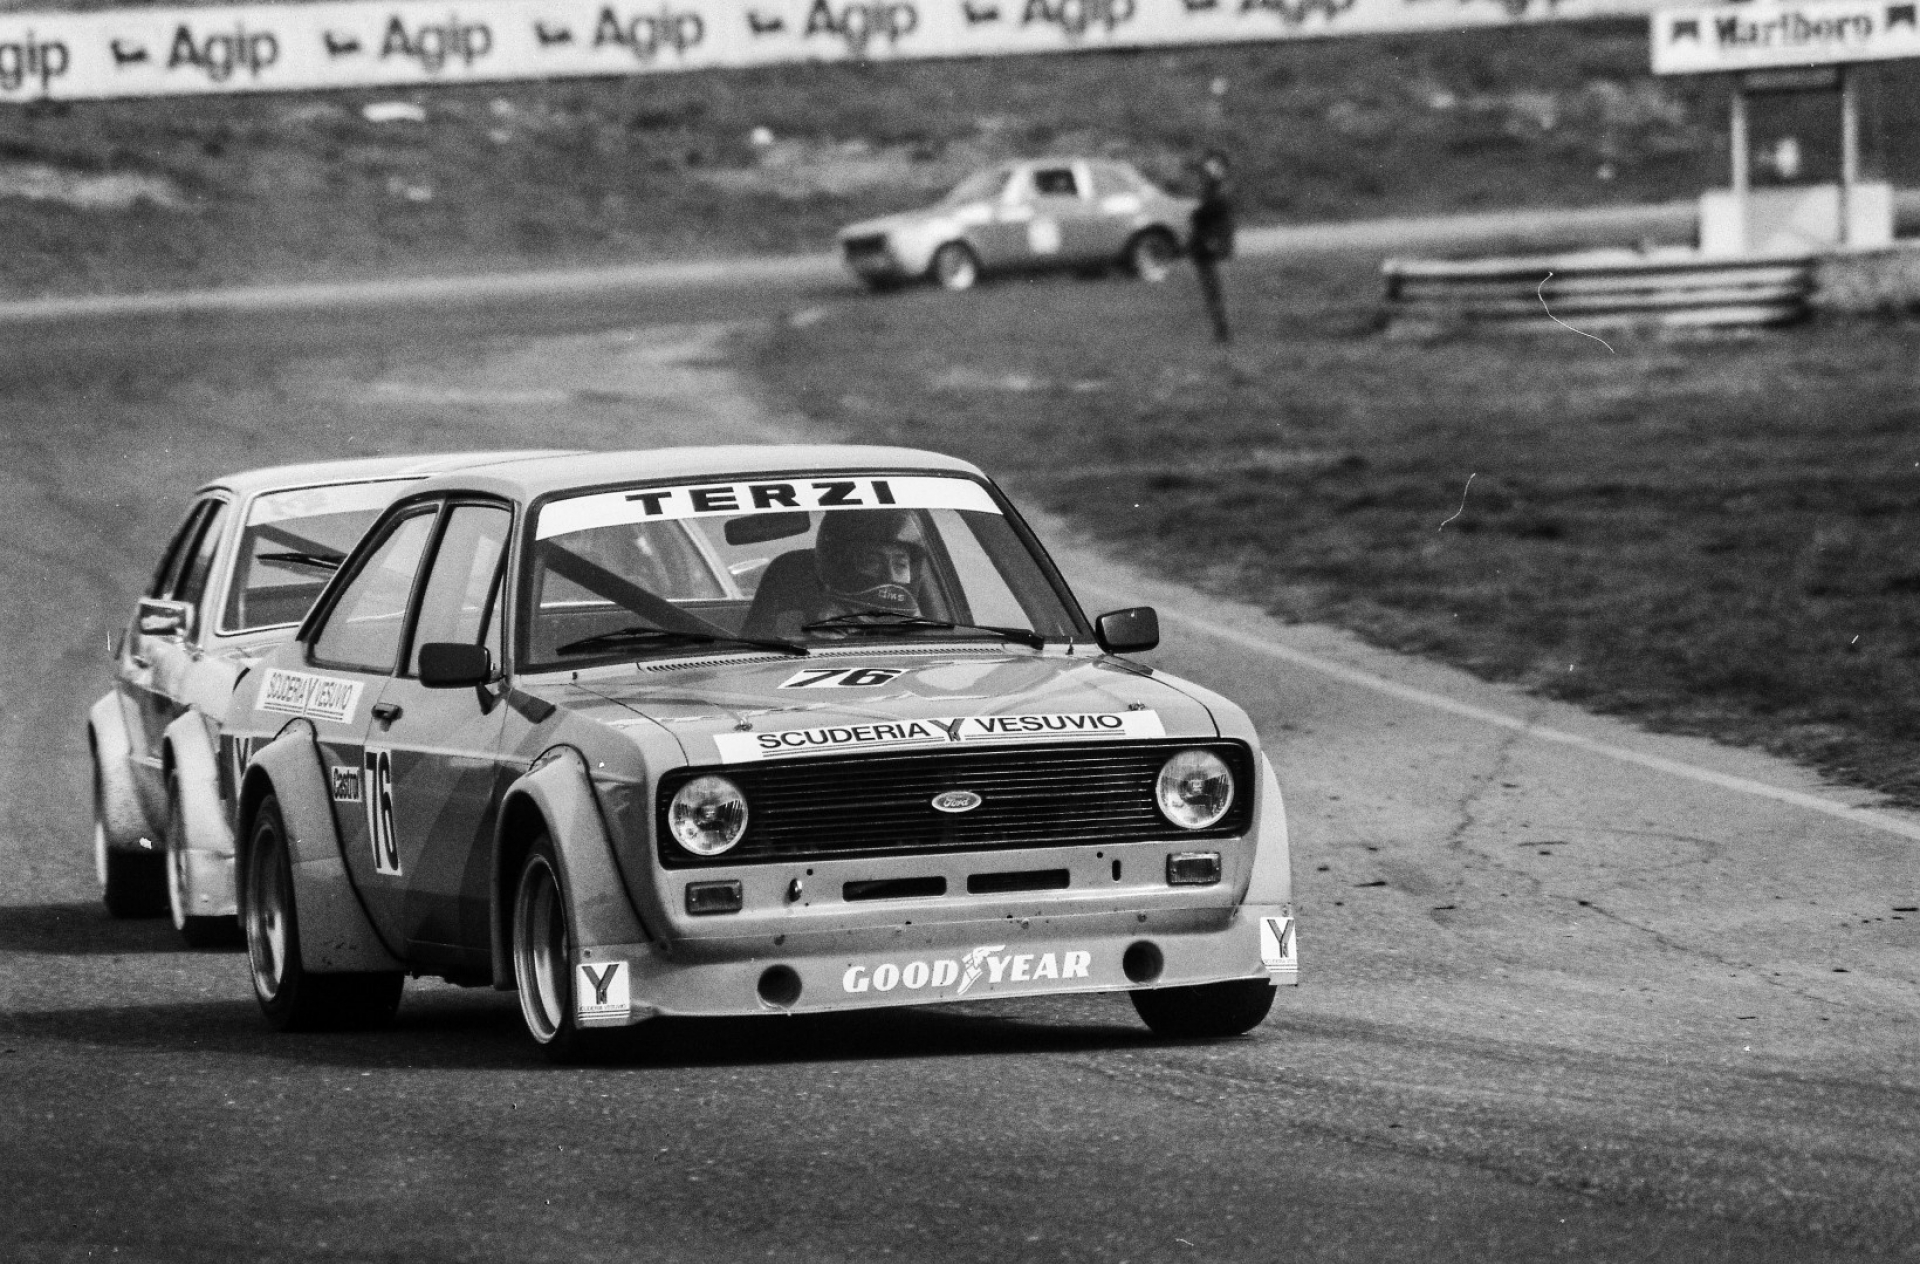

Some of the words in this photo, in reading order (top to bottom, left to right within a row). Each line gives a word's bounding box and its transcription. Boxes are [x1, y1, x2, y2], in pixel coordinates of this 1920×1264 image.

[166, 19, 279, 83] Agip
[380, 8, 494, 74] Agip
[625, 480, 897, 516] TERZI
[786, 668, 902, 687] 76
[758, 722, 932, 749] SCUDERIA
[974, 714, 1123, 733] VESUVIO
[365, 751, 399, 871] 76
[842, 959, 959, 993] GOOD
[986, 950, 1092, 984] YEAR
